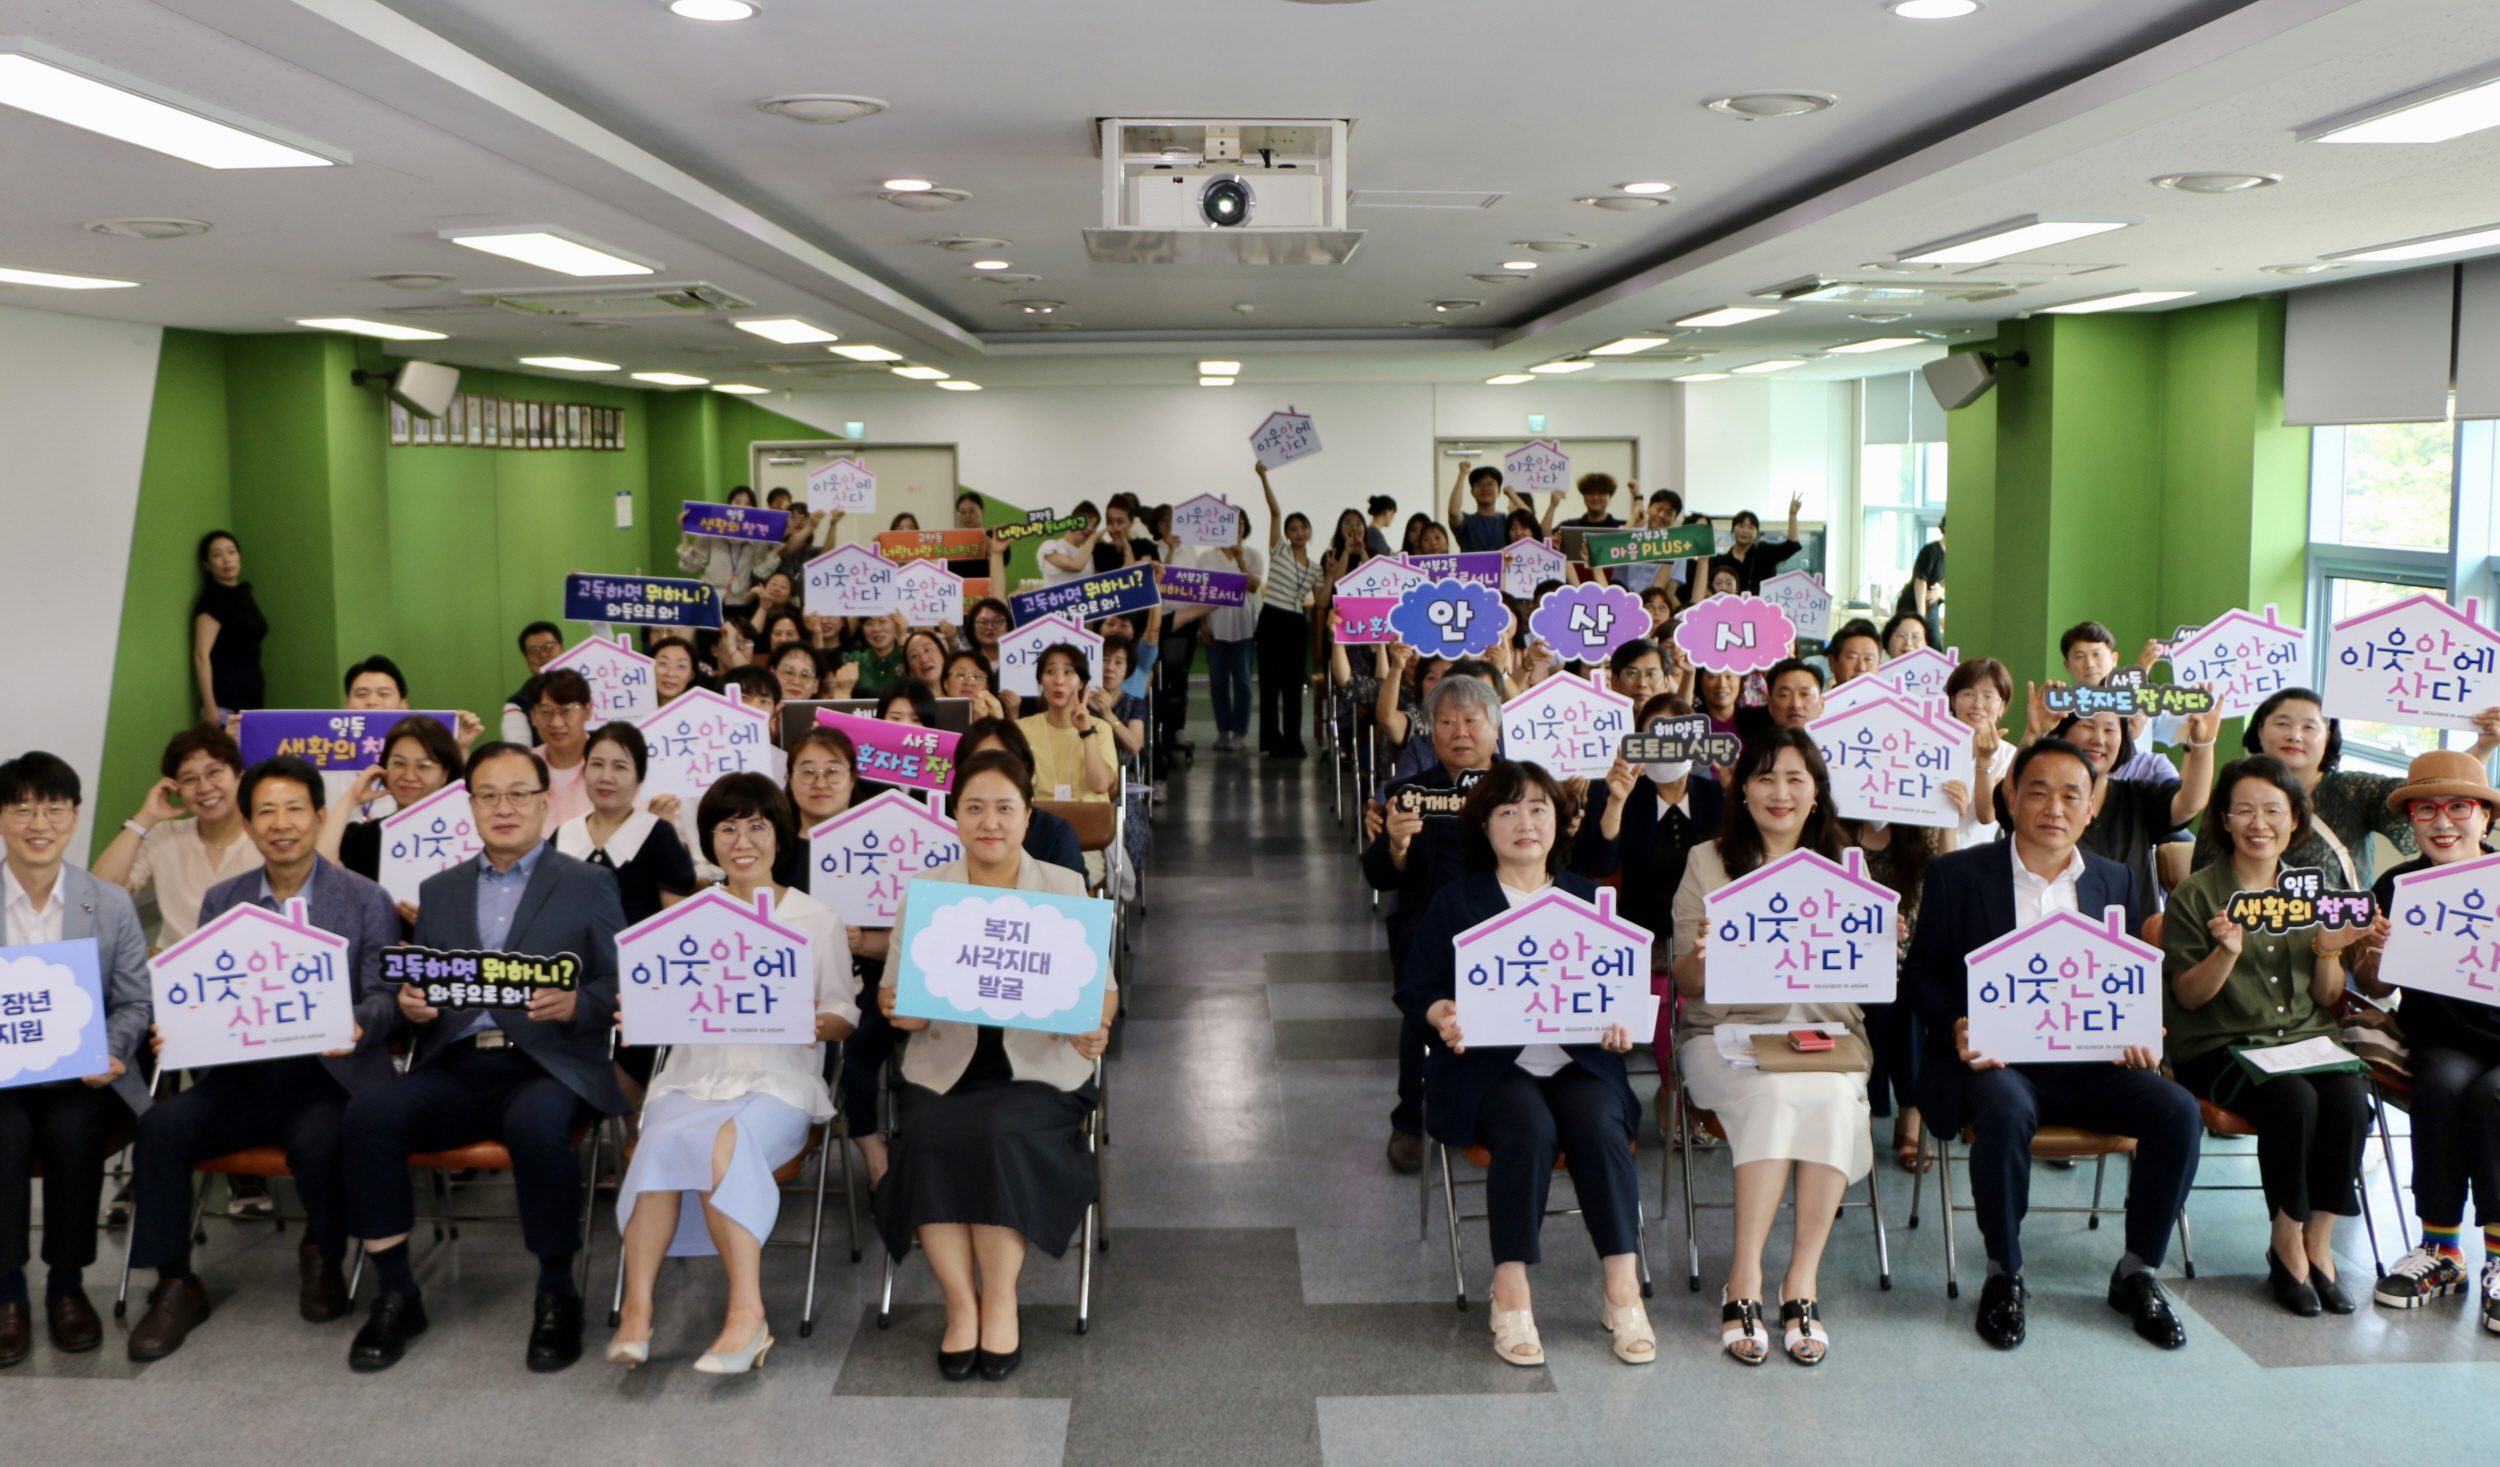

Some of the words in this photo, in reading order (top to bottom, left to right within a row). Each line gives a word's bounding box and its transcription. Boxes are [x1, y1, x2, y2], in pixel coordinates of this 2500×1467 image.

[1257, 421, 1310, 451] 이웃안에
[1280, 436, 1308, 459] 산다
[1508, 455, 1565, 473] 이웃안에
[813, 473, 872, 491] 이웃안에
[1527, 473, 1557, 489] 산다
[833, 491, 864, 509] 산다
[1177, 506, 1234, 525] 이웃안에
[1196, 524, 1226, 541] 산다
[1610, 543, 1638, 560] 마음
[1642, 539, 1693, 556] PLUS+
[811, 562, 891, 587] 이웃안에
[1176, 571, 1210, 585] 선부2동
[578, 579, 642, 602] 고독하면
[645, 583, 711, 605] 뭐하니?
[839, 586, 881, 610] 산다
[1022, 585, 1083, 613] 고독하면
[1084, 570, 1144, 600] 뭐하니?
[1100, 598, 1121, 612] 와!
[1199, 585, 1244, 601] 홀로서니
[1765, 586, 1827, 611] 이웃안에
[606, 602, 656, 620] 와동으로
[658, 606, 679, 620] 와!
[910, 600, 948, 620] 산다
[1427, 600, 1474, 642] 안
[1569, 604, 1615, 646] 산
[1346, 621, 1366, 634] 나
[1714, 621, 1755, 651] 시
[2183, 636, 2297, 682] 이웃안에
[2340, 627, 2495, 674] 이웃안에
[2111, 671, 2141, 689] 사동
[2225, 670, 2286, 709] 산다
[2388, 671, 2472, 714] 산다
[2050, 690, 2073, 706] 나
[2076, 688, 2132, 712] 혼자도
[2135, 688, 2160, 711] 잘
[2162, 690, 2208, 710] 산다
[329, 716, 366, 738] 일동
[1512, 701, 1622, 740] 이웃안에
[1654, 719, 1705, 740] 해양동
[648, 715, 759, 757] 이웃안에
[903, 733, 939, 755] 사동
[1626, 739, 1683, 758] 도토리
[1689, 738, 1735, 761] 식당
[1820, 727, 1950, 770] 이웃안에
[856, 743, 920, 777] 혼자도
[925, 755, 953, 784] 잘
[1551, 736, 1611, 772] 산다
[1860, 769, 1933, 810] 산다
[821, 829, 960, 875] 이웃안에
[868, 874, 904, 916] 산
[2284, 875, 2318, 898] 일동
[1720, 888, 1883, 943] 이웃안에
[2233, 897, 2311, 927] 생활의
[2317, 896, 2369, 924] 참견
[2405, 889, 2500, 940] 이웃
[984, 917, 1031, 944] 복지
[168, 940, 333, 1004] 이웃안에
[385, 954, 477, 982] 고독하면
[482, 957, 574, 986] 뭐하니?
[632, 931, 796, 986] 이웃안에
[956, 944, 1052, 975] 사각지대
[1468, 931, 1634, 987] 이웃안에
[1775, 940, 1863, 989] 산다
[978, 974, 1025, 1001] 발굴
[1980, 949, 2144, 1004] 이웃안에
[1, 989, 52, 1016] 장년
[428, 982, 499, 1006] 와동으로
[501, 986, 531, 1007] 와!
[689, 984, 778, 1032] 산다
[1524, 983, 1614, 1032] 산다
[0, 1019, 44, 1044] 지원
[228, 991, 317, 1046] 산다
[2036, 1001, 2125, 1050] 산다
